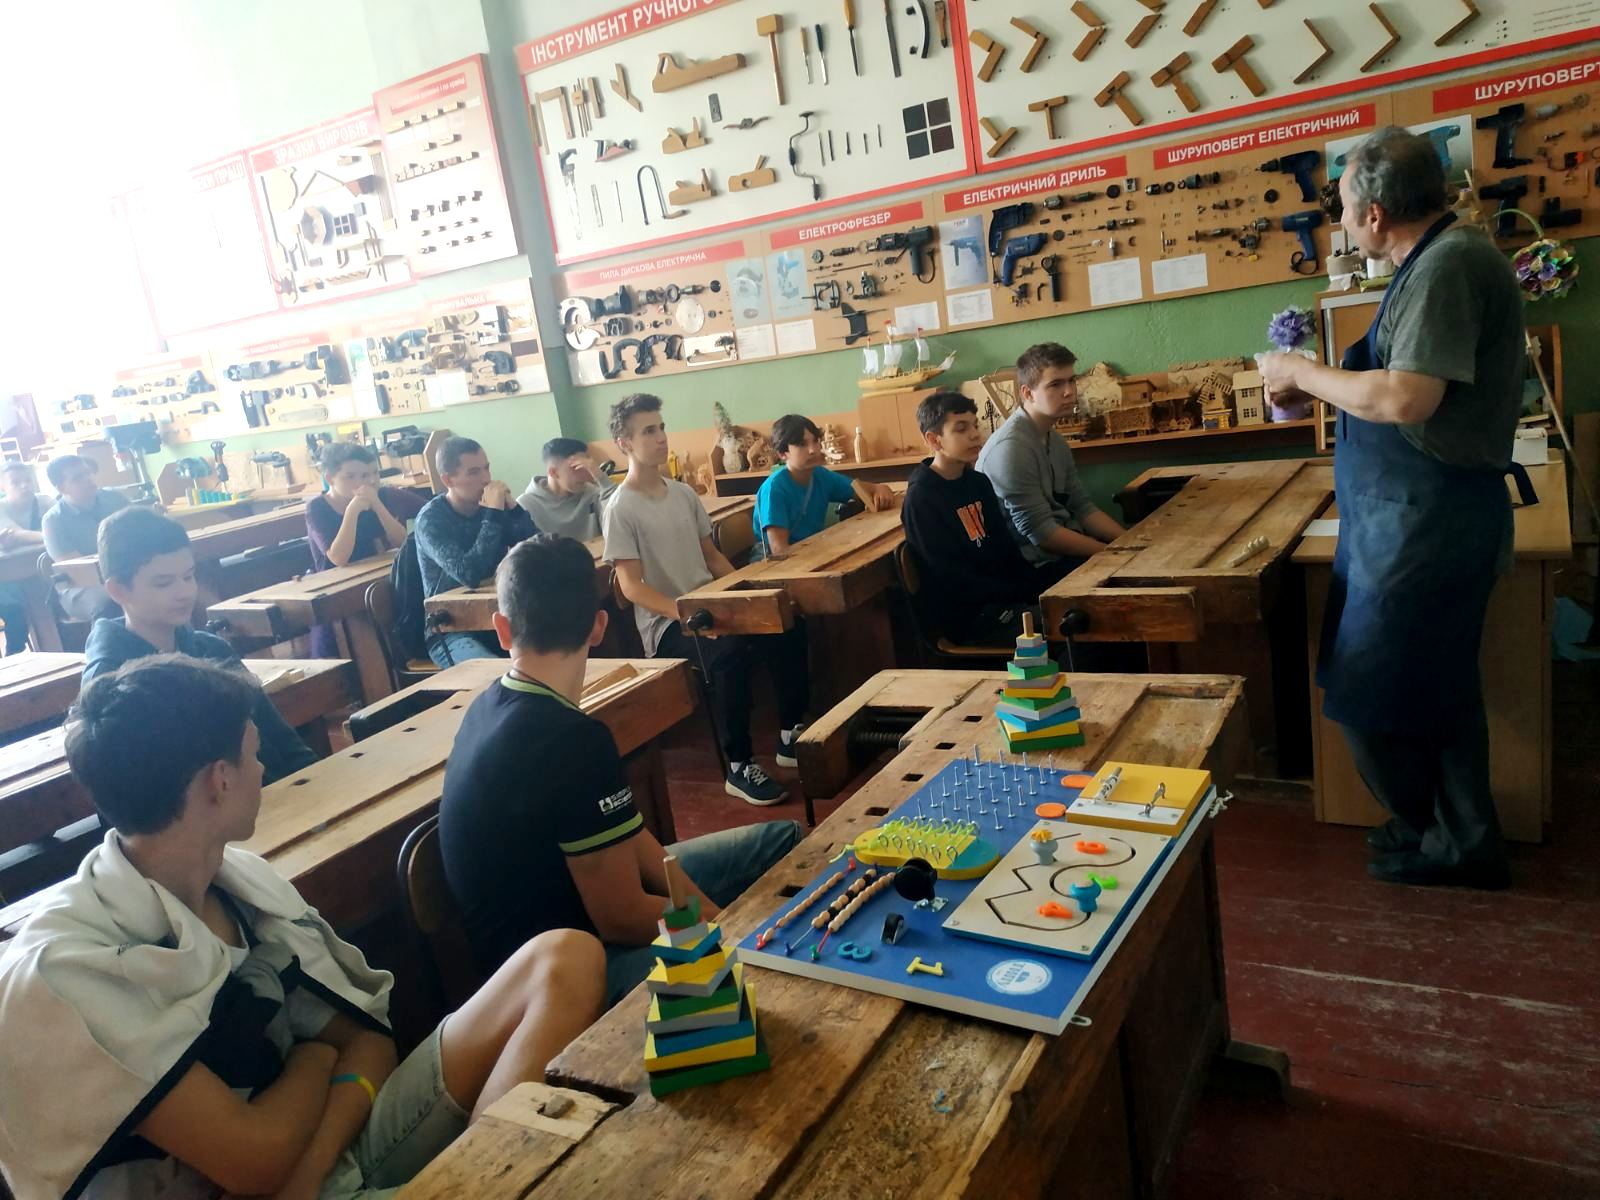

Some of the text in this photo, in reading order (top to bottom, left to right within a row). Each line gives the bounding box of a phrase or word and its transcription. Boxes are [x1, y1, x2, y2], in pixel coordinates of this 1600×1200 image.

[530, 0, 715, 65] ІНСТРУМЕНТ РУЧНО
[1167, 111, 1361, 164] ШУРУПОВЕРТ ЕЛЕКТРИЧНИЙ
[963, 164, 1107, 206] ЕЛЕКТРИЧНИЙ ДРИЛЬ
[798, 211, 892, 242] ЕЛЕКТРОФРЕЗЕР
[620, 261, 656, 277] ДИСКОВА
[656, 251, 707, 269] ЕЛЕКТРИЧНА
